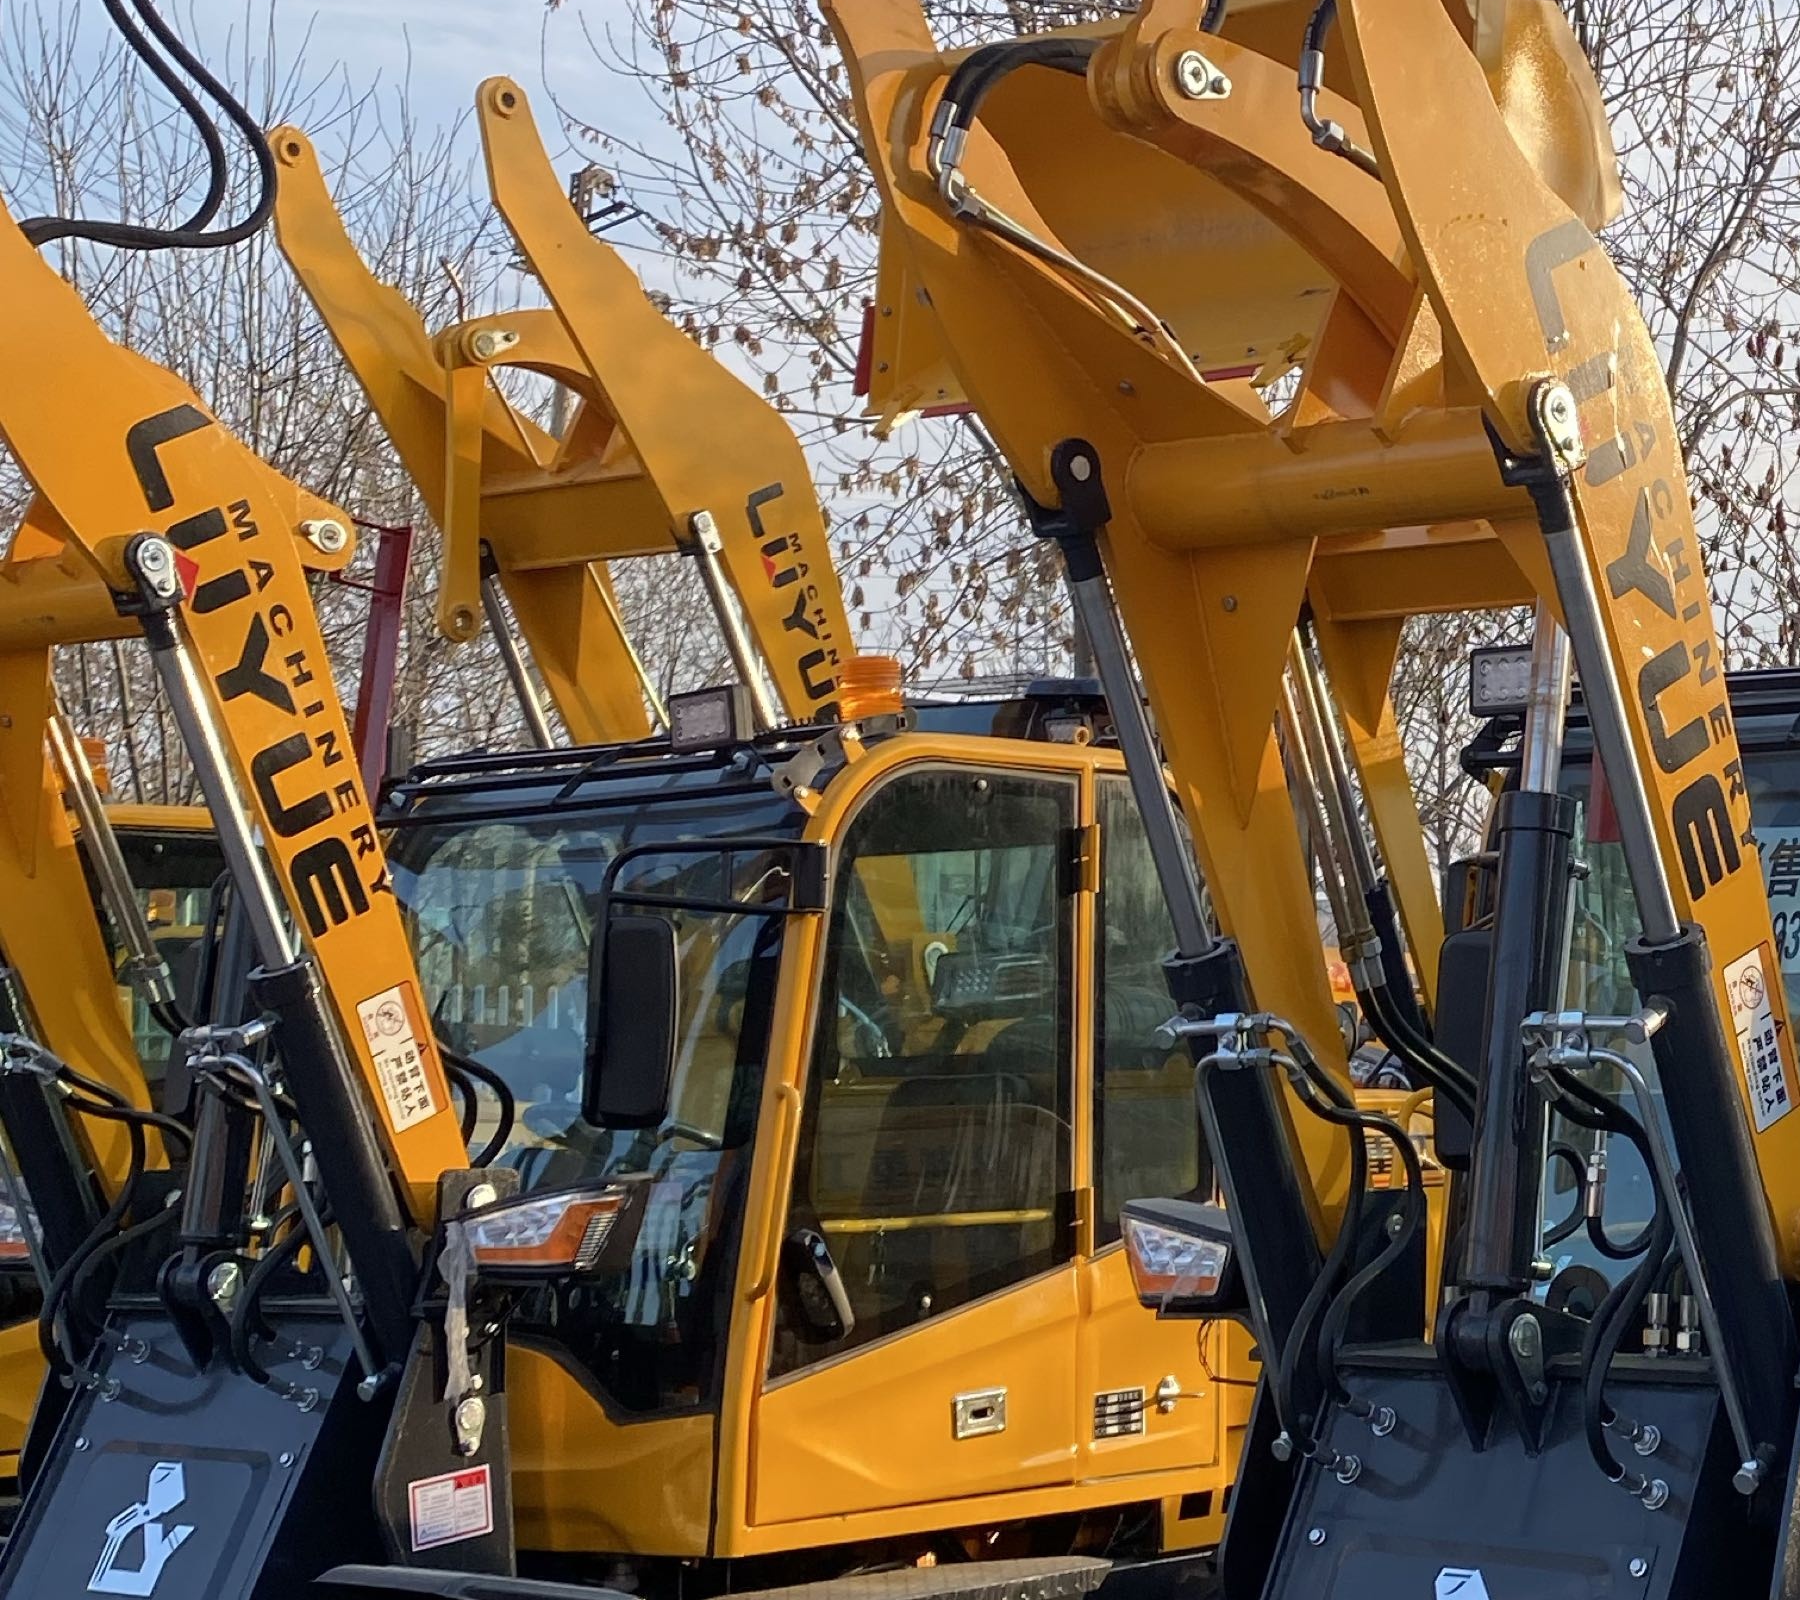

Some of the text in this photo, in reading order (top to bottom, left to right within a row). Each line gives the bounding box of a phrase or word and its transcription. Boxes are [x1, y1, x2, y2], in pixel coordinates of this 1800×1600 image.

[788, 532, 842, 690] MACHIN
[227, 499, 395, 896] MACHINERY
[1752, 1037, 1772, 1114] 严禁站人
